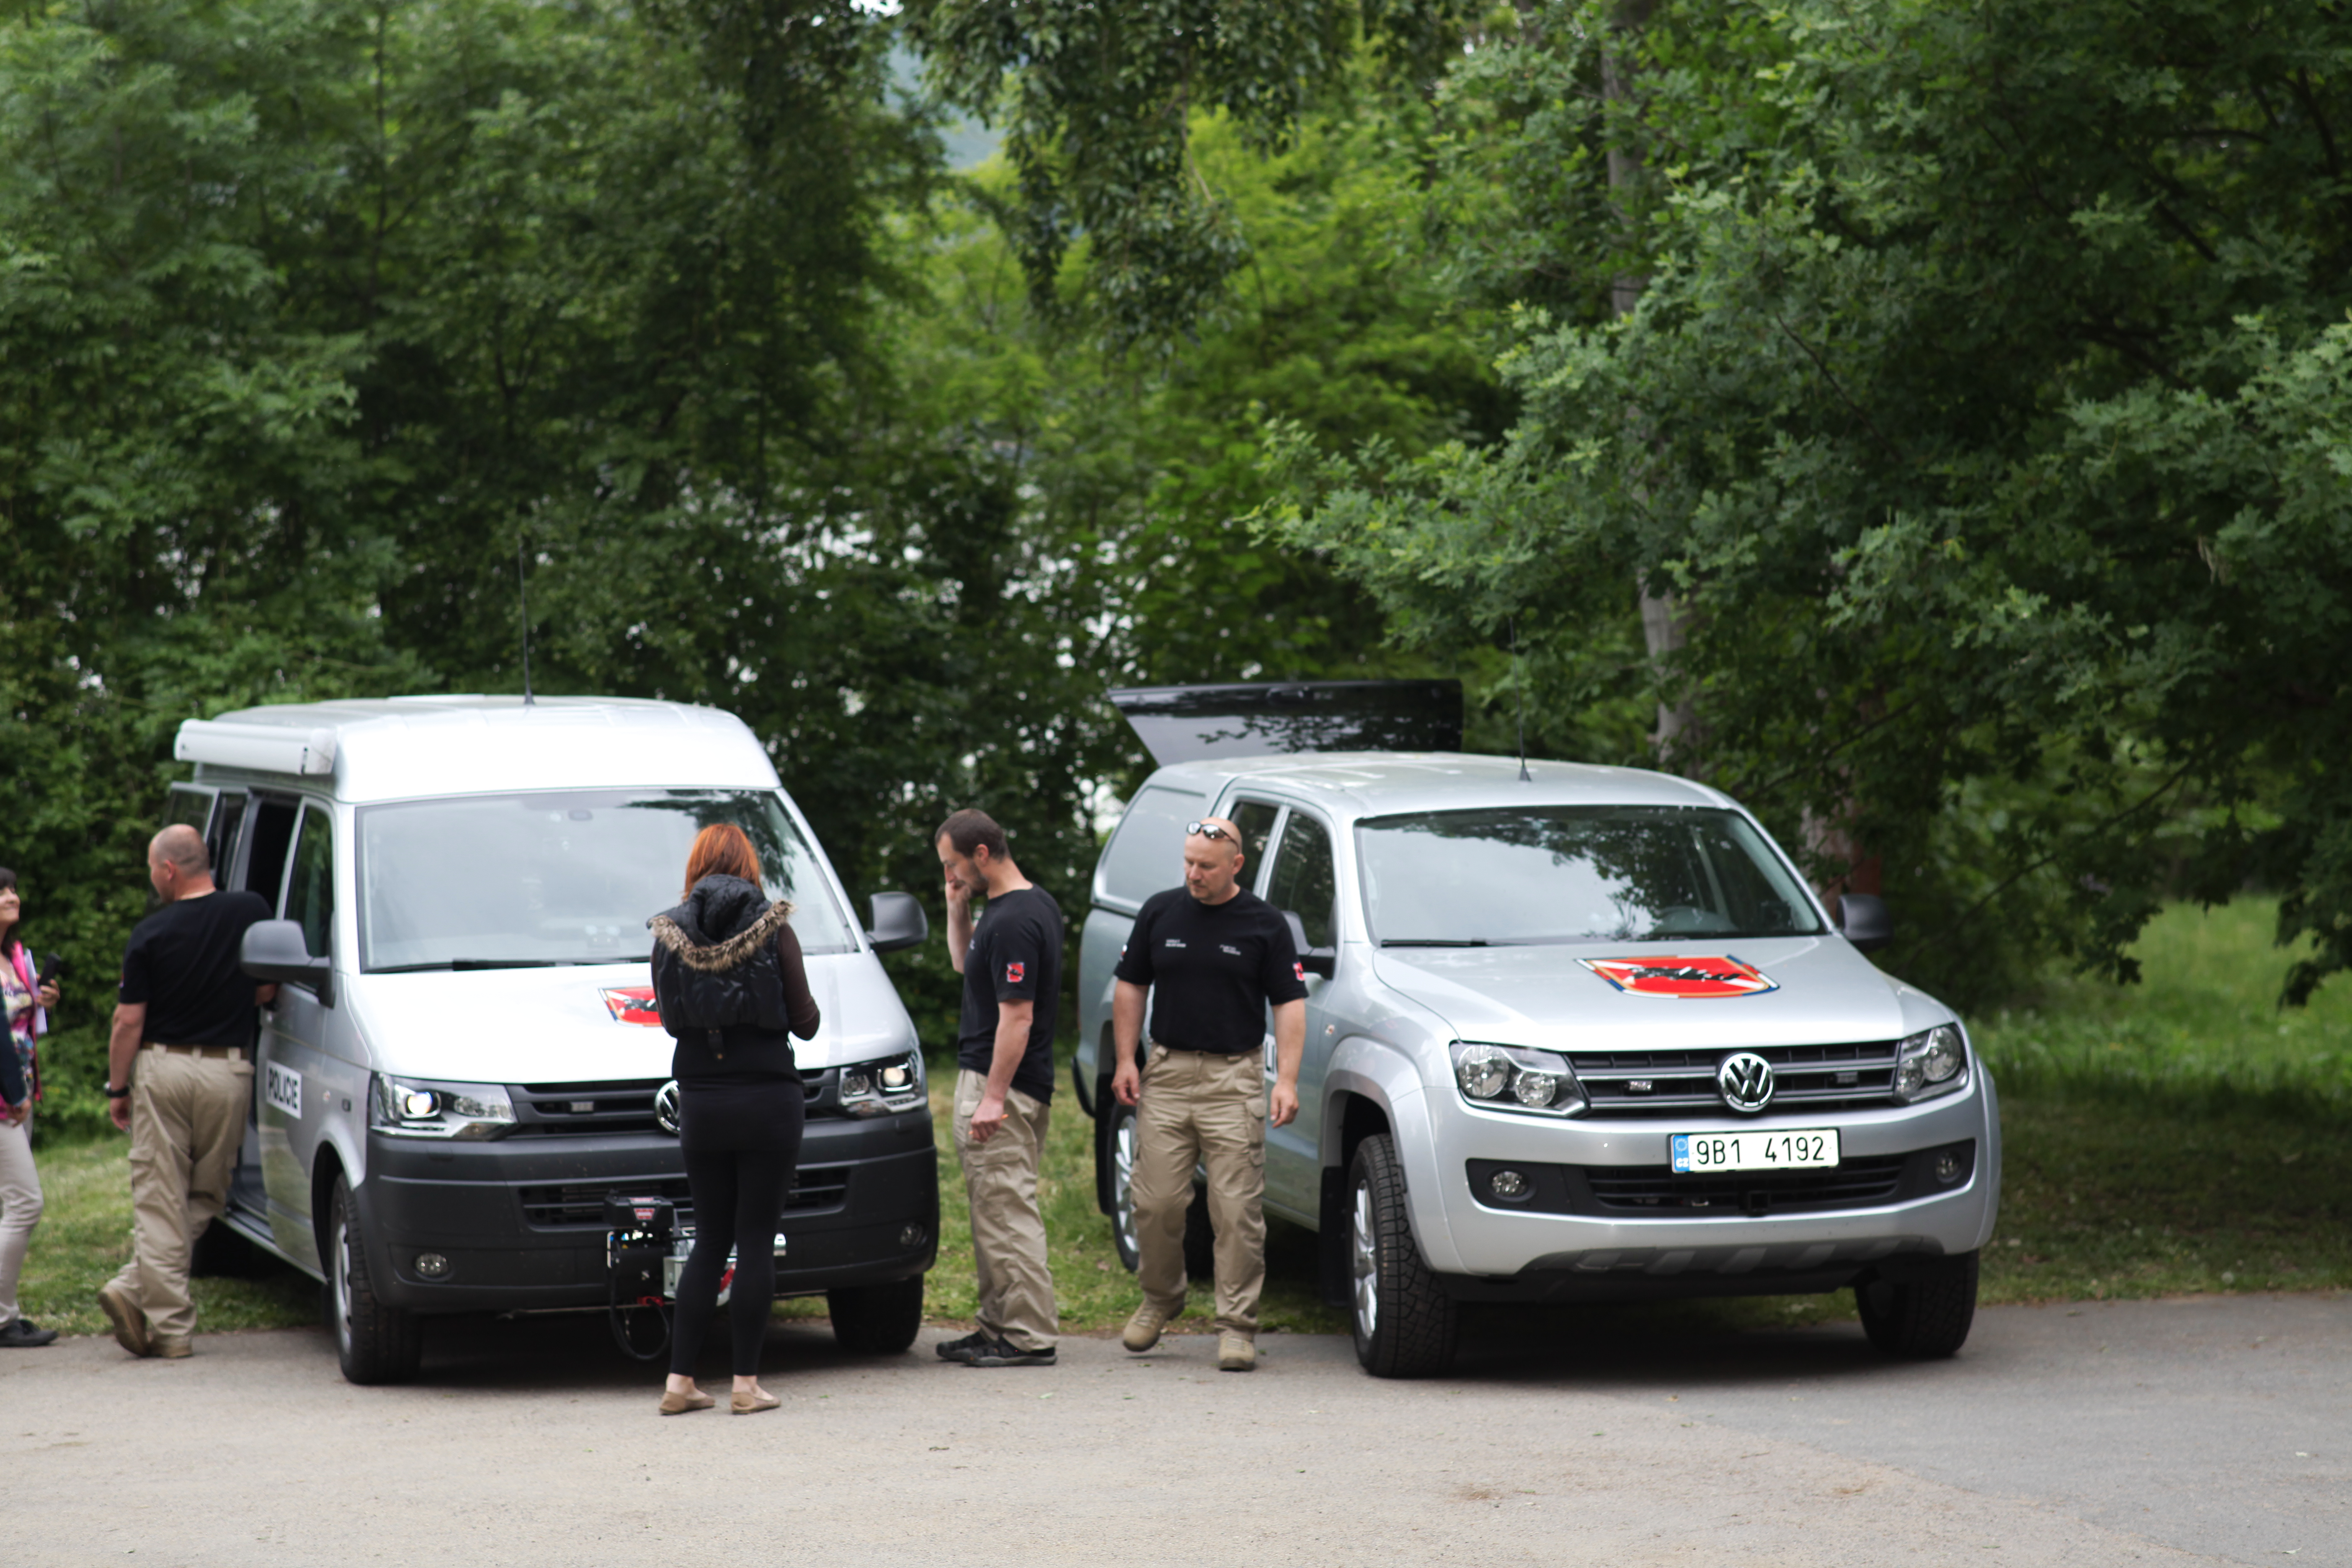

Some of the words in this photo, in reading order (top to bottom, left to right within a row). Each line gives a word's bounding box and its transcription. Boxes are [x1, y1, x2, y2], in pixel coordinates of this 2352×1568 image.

[269, 1068, 298, 1109] POLICE
[1676, 1157, 1689, 1168] CZ
[1697, 1139, 1741, 1165] 9B1
[1765, 1136, 1825, 1163] 4192
